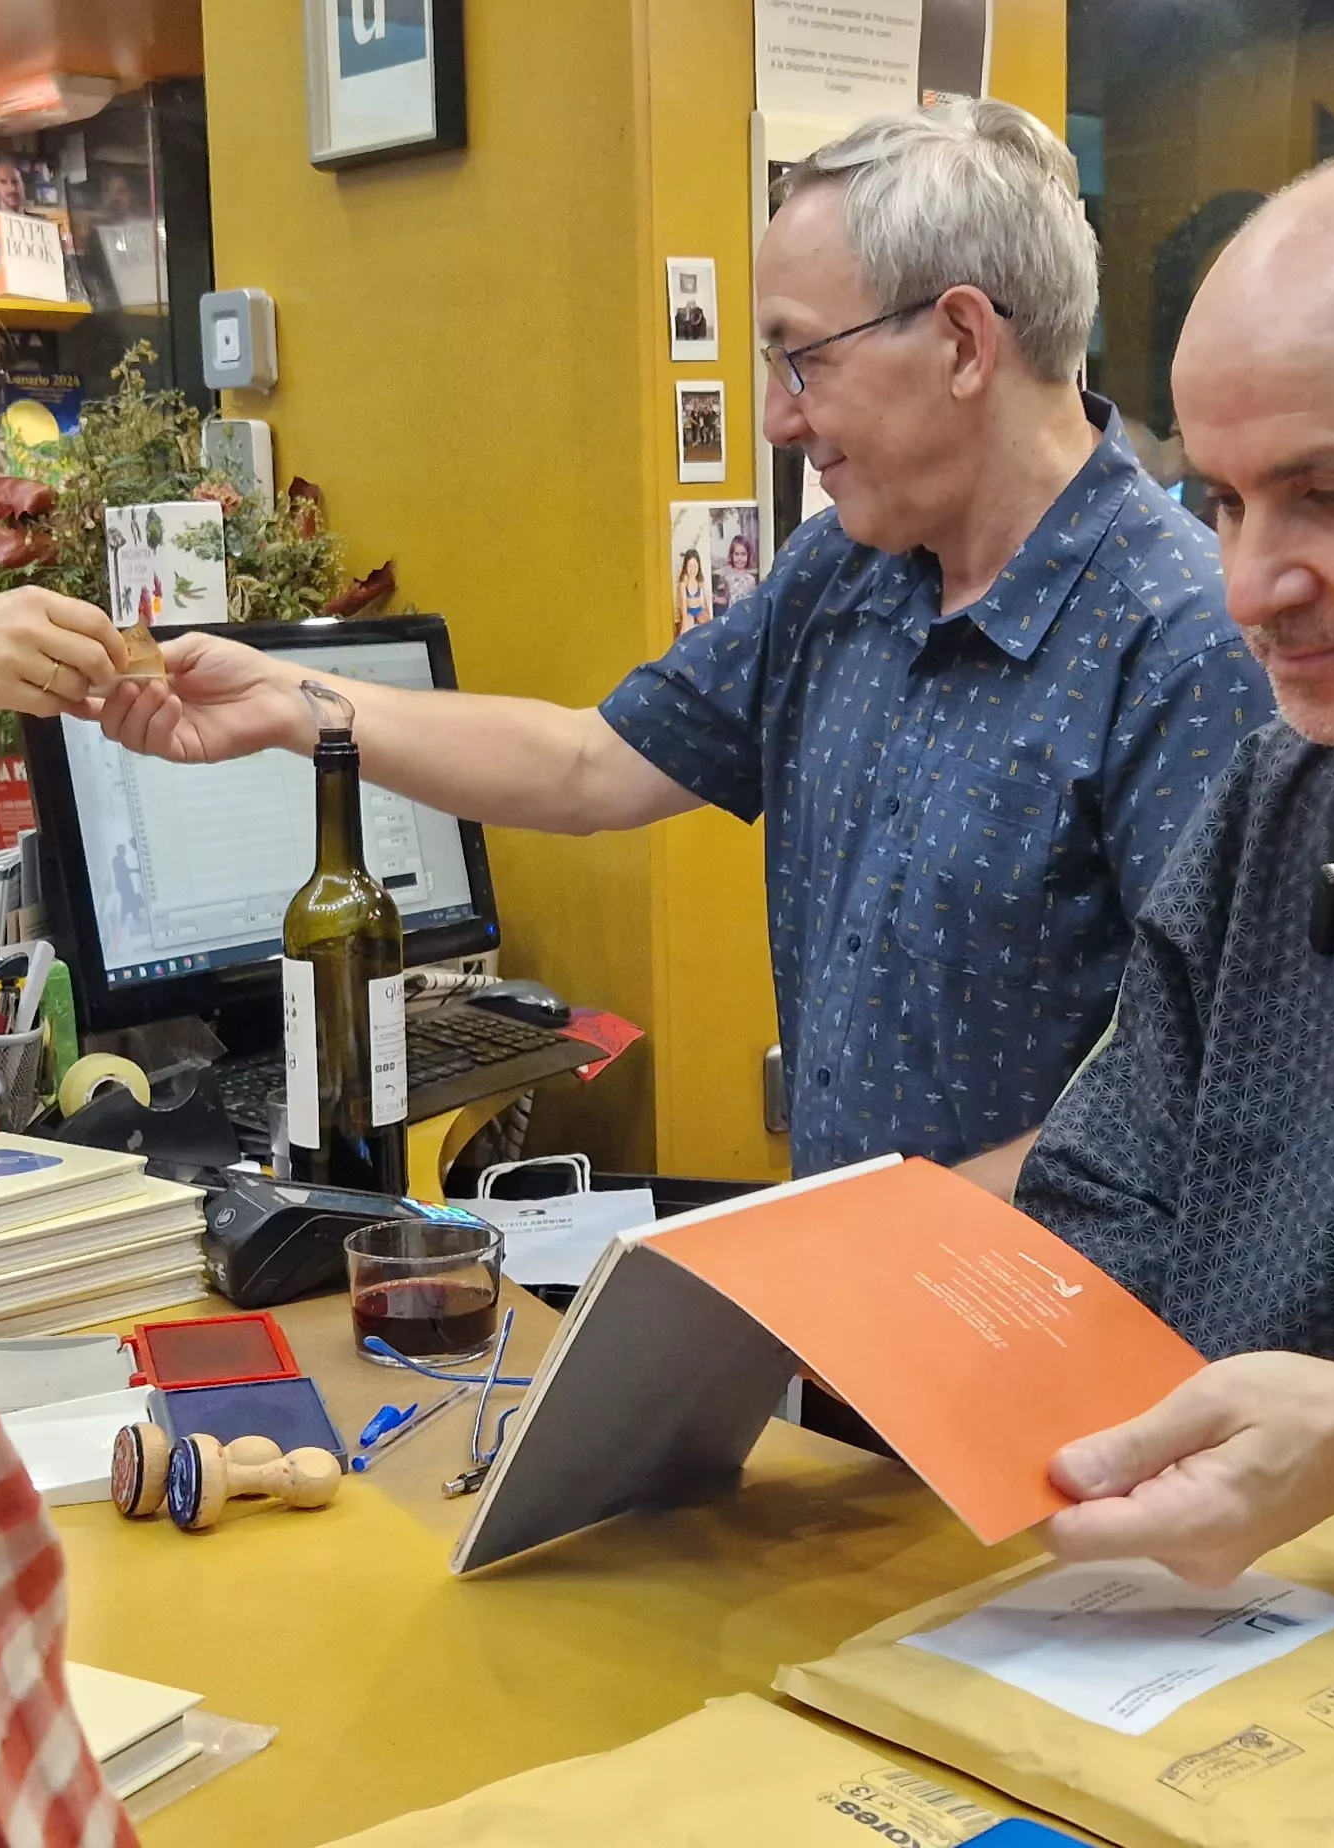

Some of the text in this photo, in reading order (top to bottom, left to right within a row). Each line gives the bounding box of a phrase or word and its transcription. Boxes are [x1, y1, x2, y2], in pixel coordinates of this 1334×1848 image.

[6, 216, 50, 245] TYPE
[6, 237, 56, 265] BOOK
[849, 1786, 877, 1802] 13
